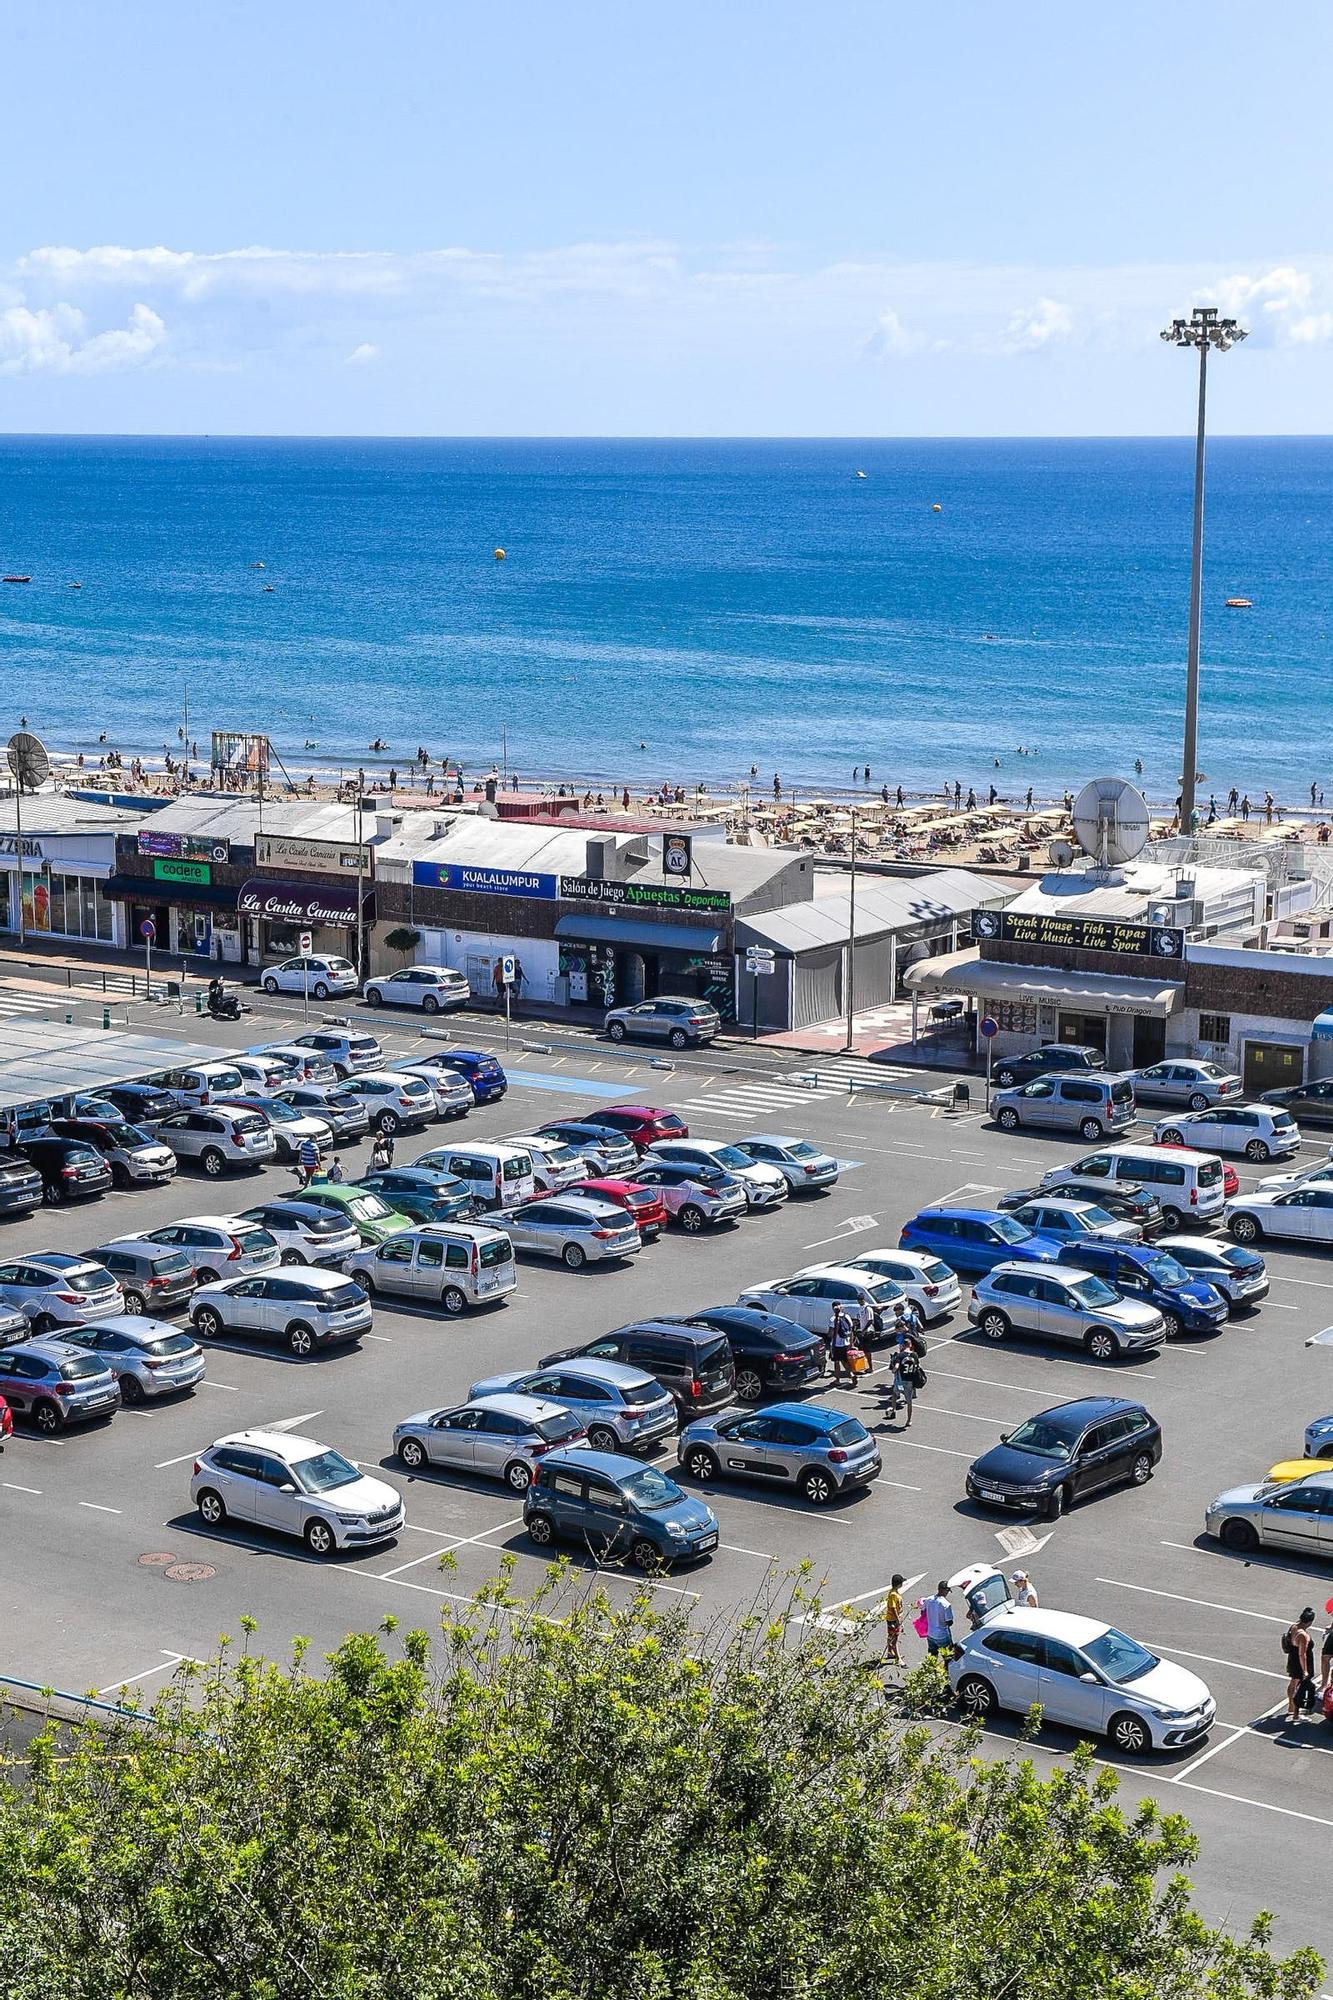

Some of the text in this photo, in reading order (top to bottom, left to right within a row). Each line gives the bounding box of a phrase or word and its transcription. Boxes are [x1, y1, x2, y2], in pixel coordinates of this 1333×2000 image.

[275, 842, 337, 859] La Casita Canaria
[162, 863, 202, 878] codere
[462, 871, 540, 888] KUALALUMPUR
[562, 880, 730, 908] Salón de Juego Apuestas Deportivas
[241, 894, 261, 910] La
[265, 896, 304, 915] Casita
[306, 901, 357, 921] Canaria
[1006, 915, 1038, 928] Steak
[1040, 919, 1073, 931] House
[1083, 922, 1105, 935] Fish
[1114, 925, 1147, 939] Tapas
[1014, 929, 1037, 941] Live
[1041, 933, 1074, 945] Music
[1083, 935, 1107, 948] Live
[1111, 938, 1141, 952] Sport
[1019, 994, 1062, 1006] LIVE MUSIC
[1112, 1003, 1152, 1015] Pub Dragon
[903, 1364, 915, 1374] 34
